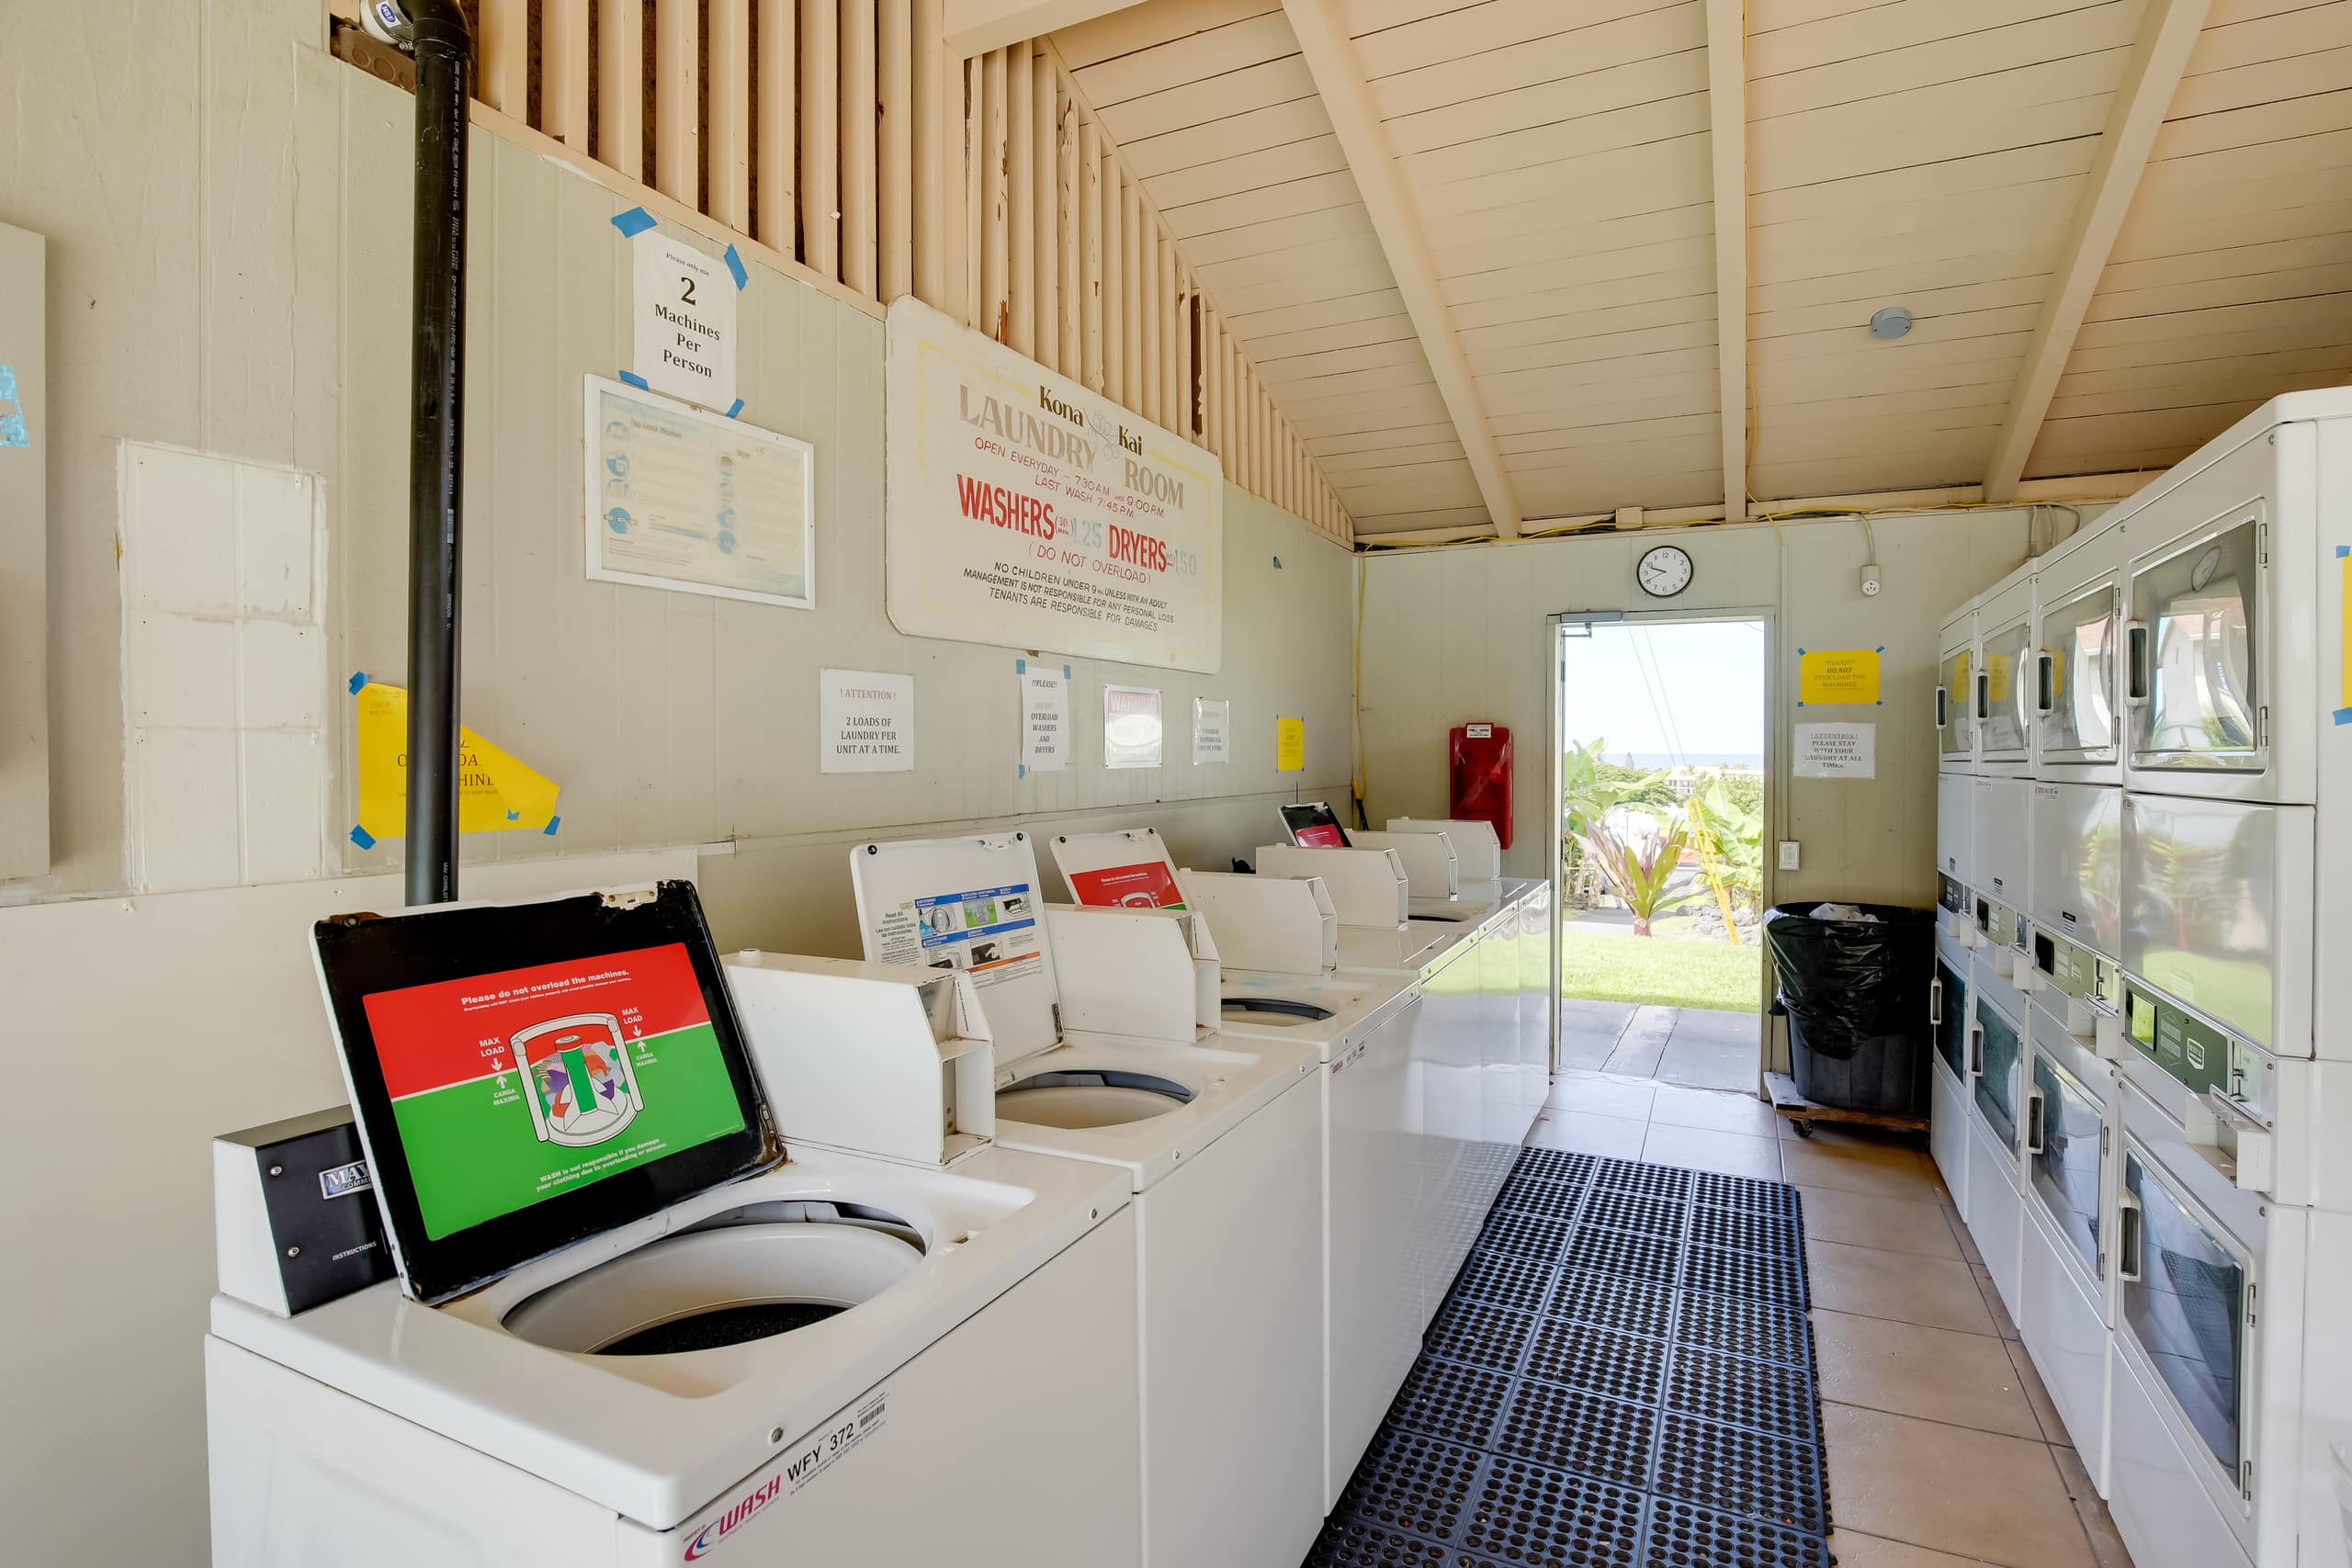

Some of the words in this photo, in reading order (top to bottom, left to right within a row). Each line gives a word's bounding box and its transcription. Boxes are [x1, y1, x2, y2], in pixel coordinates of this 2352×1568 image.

[666, 253, 686, 265] Please
[686, 262, 699, 273] only
[699, 267, 709, 276] use
[681, 276, 696, 306] 2
[655, 303, 720, 341] Machines
[676, 333, 701, 353] Per
[663, 348, 712, 378] Person
[1039, 385, 1083, 427] Kona
[1118, 424, 1142, 456] Kai
[959, 383, 1098, 473] LAUNDRY
[1125, 457, 1184, 510] ROOM
[975, 436, 1006, 457] OPEN
[1011, 450, 1059, 477] EVERYDAY
[1035, 475, 1061, 491] LAST
[1066, 486, 1093, 503] WASH
[956, 473, 1055, 540] WASHERS
[1109, 524, 1167, 572] DRYERS
[1061, 551, 1087, 568] NOT
[964, 568, 1019, 589] MANAGEMENT
[1021, 581, 1027, 591] IS
[1028, 582, 1043, 594] NOT
[1044, 586, 1091, 604] RESPONSIBLE
[1093, 598, 1107, 608] FOR
[1107, 601, 1121, 612] ANY
[1123, 604, 1156, 620] PERSONAL
[1159, 613, 1175, 624] LOSS
[994, 561, 1010, 573] NO
[1012, 566, 1060, 585] CHILDREN
[1063, 578, 1091, 592] UNDER
[1091, 585, 1097, 593] 9
[1104, 588, 1126, 601] UNLESS
[1127, 594, 1140, 604] WITH
[1140, 596, 1148, 605] AN
[1149, 598, 1168, 609] ADULT
[989, 587, 1028, 605] TENANTS
[1030, 595, 1047, 609] ARE
[1051, 600, 1102, 620] RESPONSIBLE
[1106, 612, 1121, 623] FOR
[1125, 616, 1158, 632] DAMAGES
[846, 716, 852, 726] 2
[854, 717, 880, 727] LOADS
[881, 718, 892, 727] OF
[1031, 713, 1058, 721] OVERLOAD
[1033, 724, 1057, 732] WASHERS
[841, 730, 879, 740] LAUNDRY
[881, 732, 897, 740] PER
[1039, 735, 1051, 743] AND
[836, 744, 857, 754] UNIT
[858, 745, 870, 754] AT
[872, 745, 878, 754] A
[1035, 746, 1056, 754] DRYERS
[461, 994, 495, 1005] Please
[499, 990, 511, 998] do
[513, 987, 528, 996] not
[531, 978, 570, 992] overload
[571, 976, 586, 985] the
[588, 970, 629, 982] machines.
[622, 1007, 639, 1016] MAX
[624, 1015, 643, 1024] LOAD
[480, 1037, 500, 1047] MAX
[481, 1046, 504, 1057] LOAD
[493, 1089, 516, 1098] CARGA
[536, 1183, 551, 1192] your
[553, 1173, 580, 1186] clothing
[602, 1153, 638, 1168] overloading
[540, 1171, 561, 1182] WASH
[570, 1164, 581, 1172] not
[582, 1153, 617, 1168] responsible
[625, 1146, 636, 1155] you
[637, 1139, 660, 1150] damage
[325, 1163, 369, 1188] MAY
[333, 1241, 377, 1261] INSTRUCTIONS
[787, 1446, 821, 1482] WFY
[830, 1423, 854, 1451] 372
[719, 1474, 781, 1536] WASH
